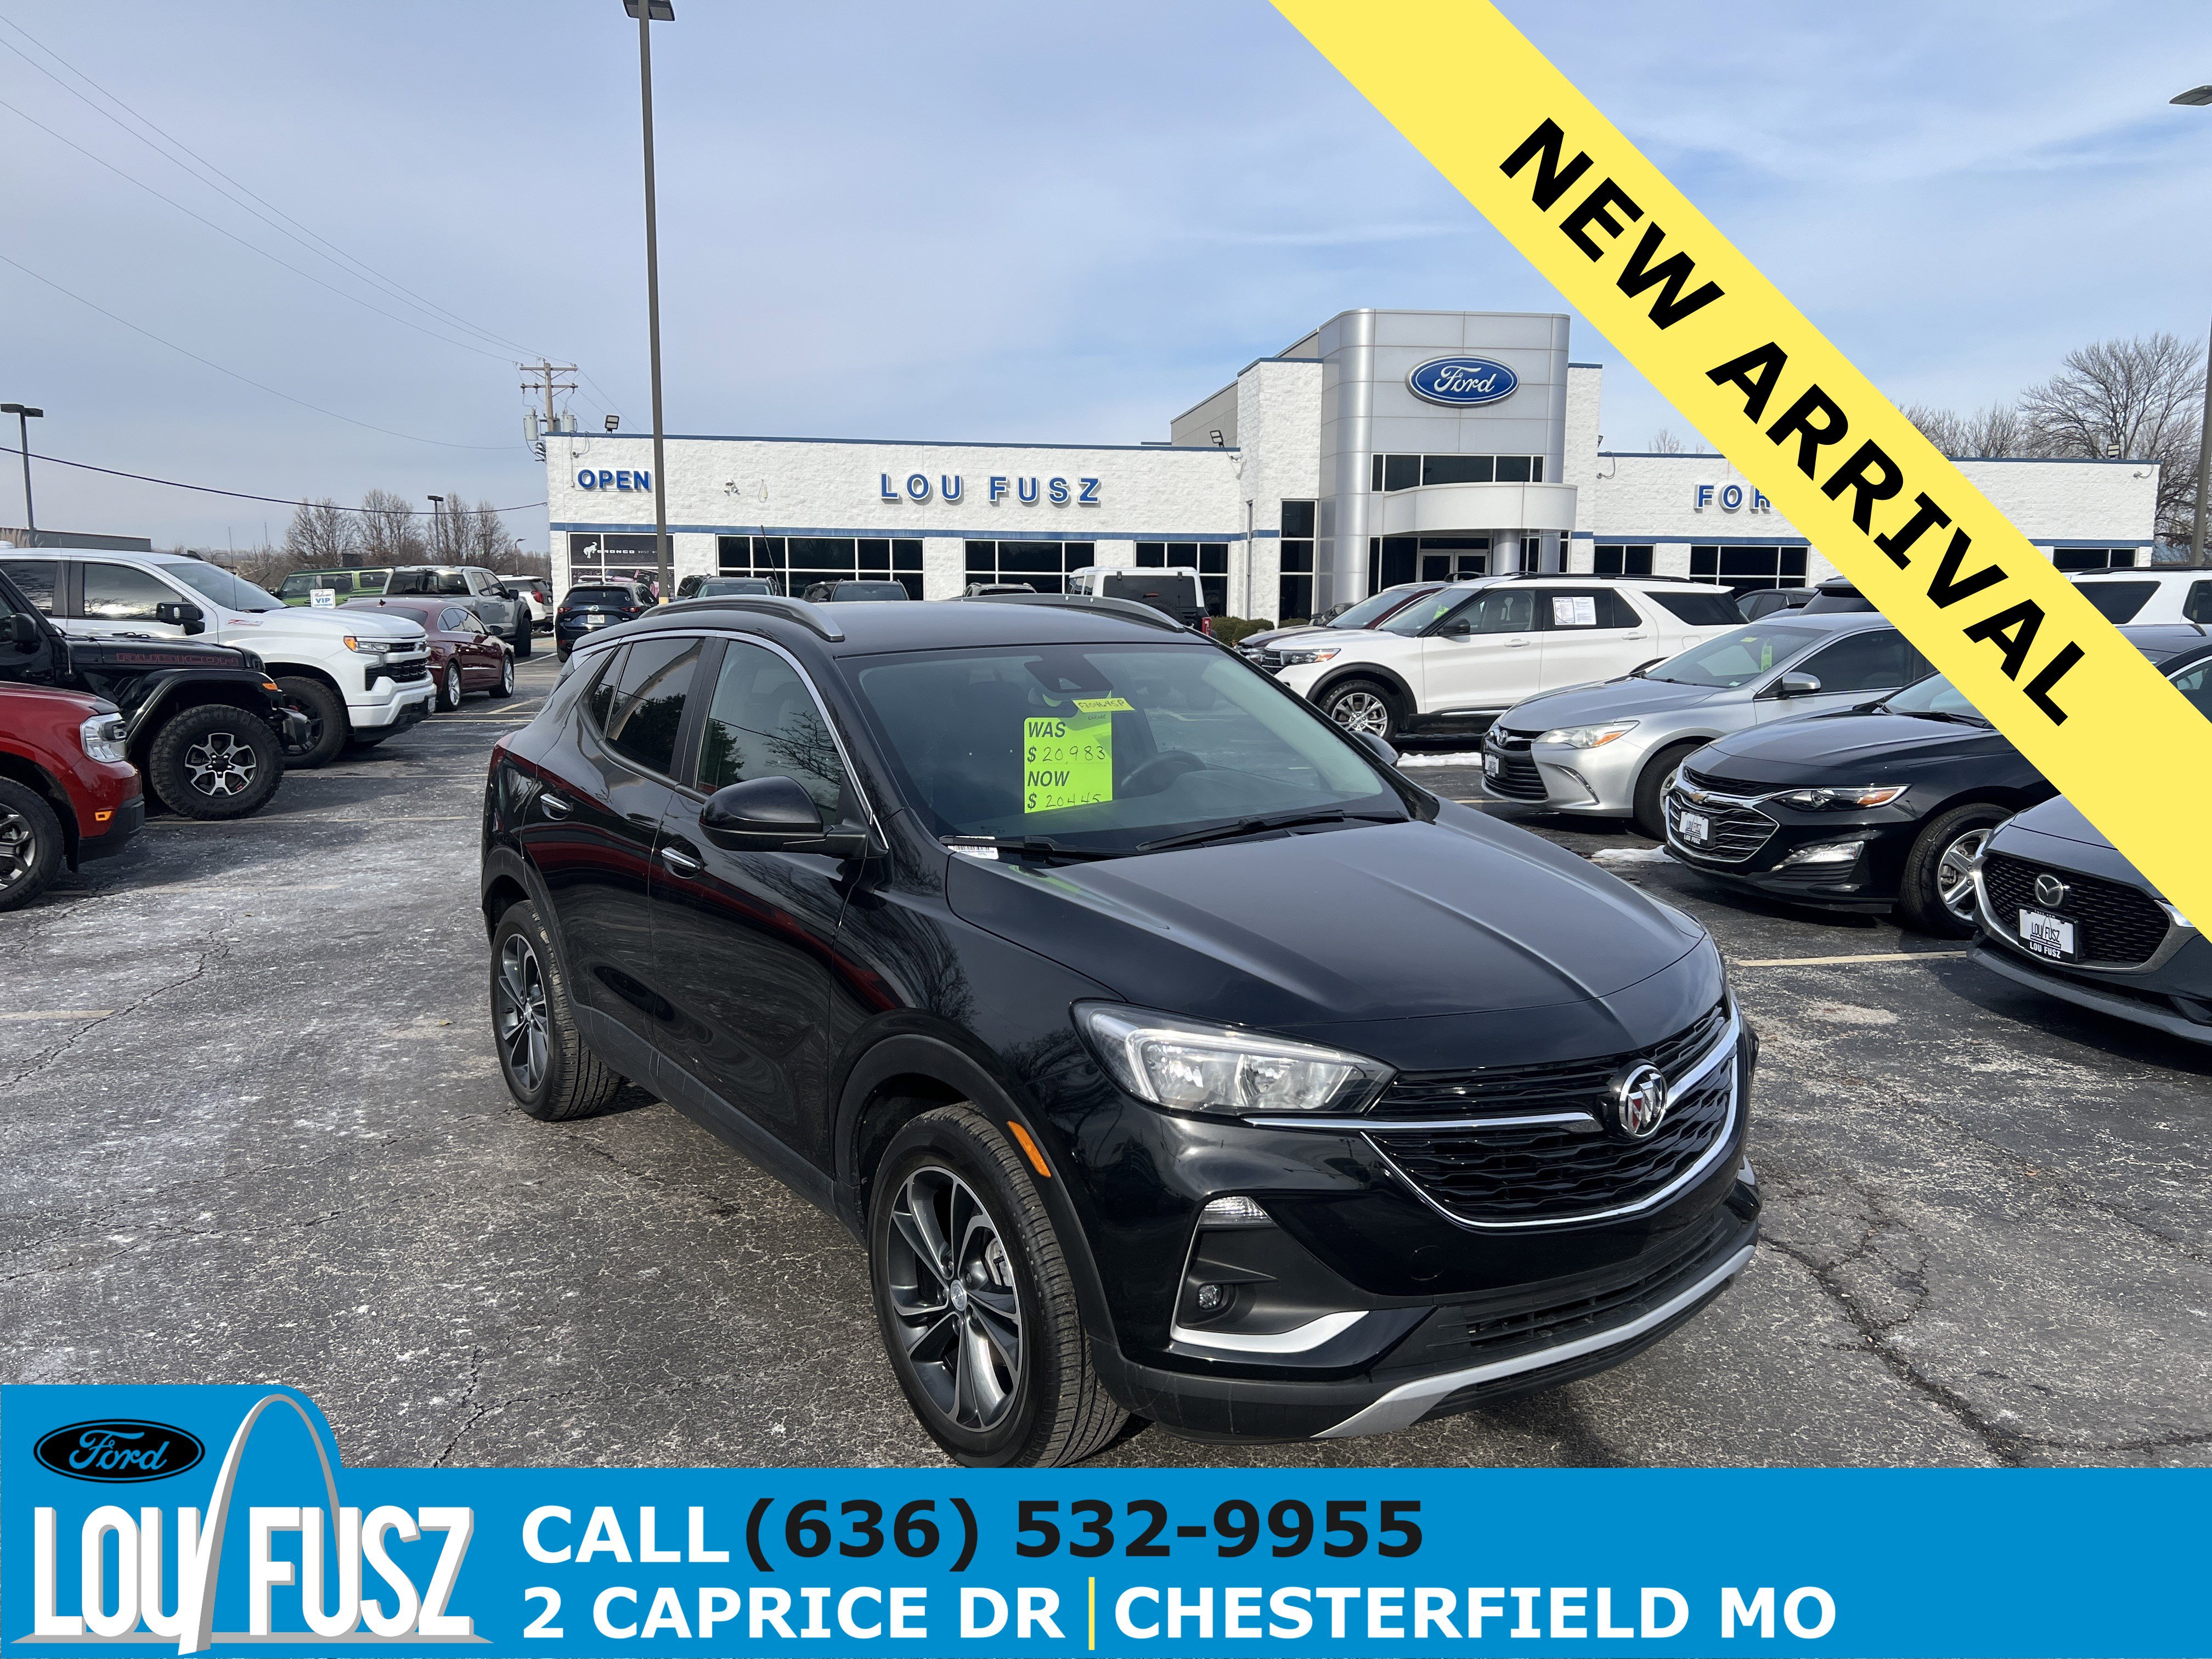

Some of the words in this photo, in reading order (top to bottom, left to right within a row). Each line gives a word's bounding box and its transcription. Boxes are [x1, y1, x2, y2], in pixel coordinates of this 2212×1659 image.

[1434, 365, 1497, 393] Ford
[578, 469, 650, 490] OPEN
[881, 473, 962, 500] LOU
[989, 476, 1099, 504] FUSZ
[1697, 484, 1771, 509] FOR
[116, 652, 239, 668] RUBICON
[1028, 721, 1066, 738] WAS
[1027, 770, 1070, 787] NOW
[2031, 922, 2042, 937] LOU
[2045, 926, 2060, 943] FUSZ
[2029, 941, 2042, 952] LOU
[2044, 945, 2061, 959] FUSZ
